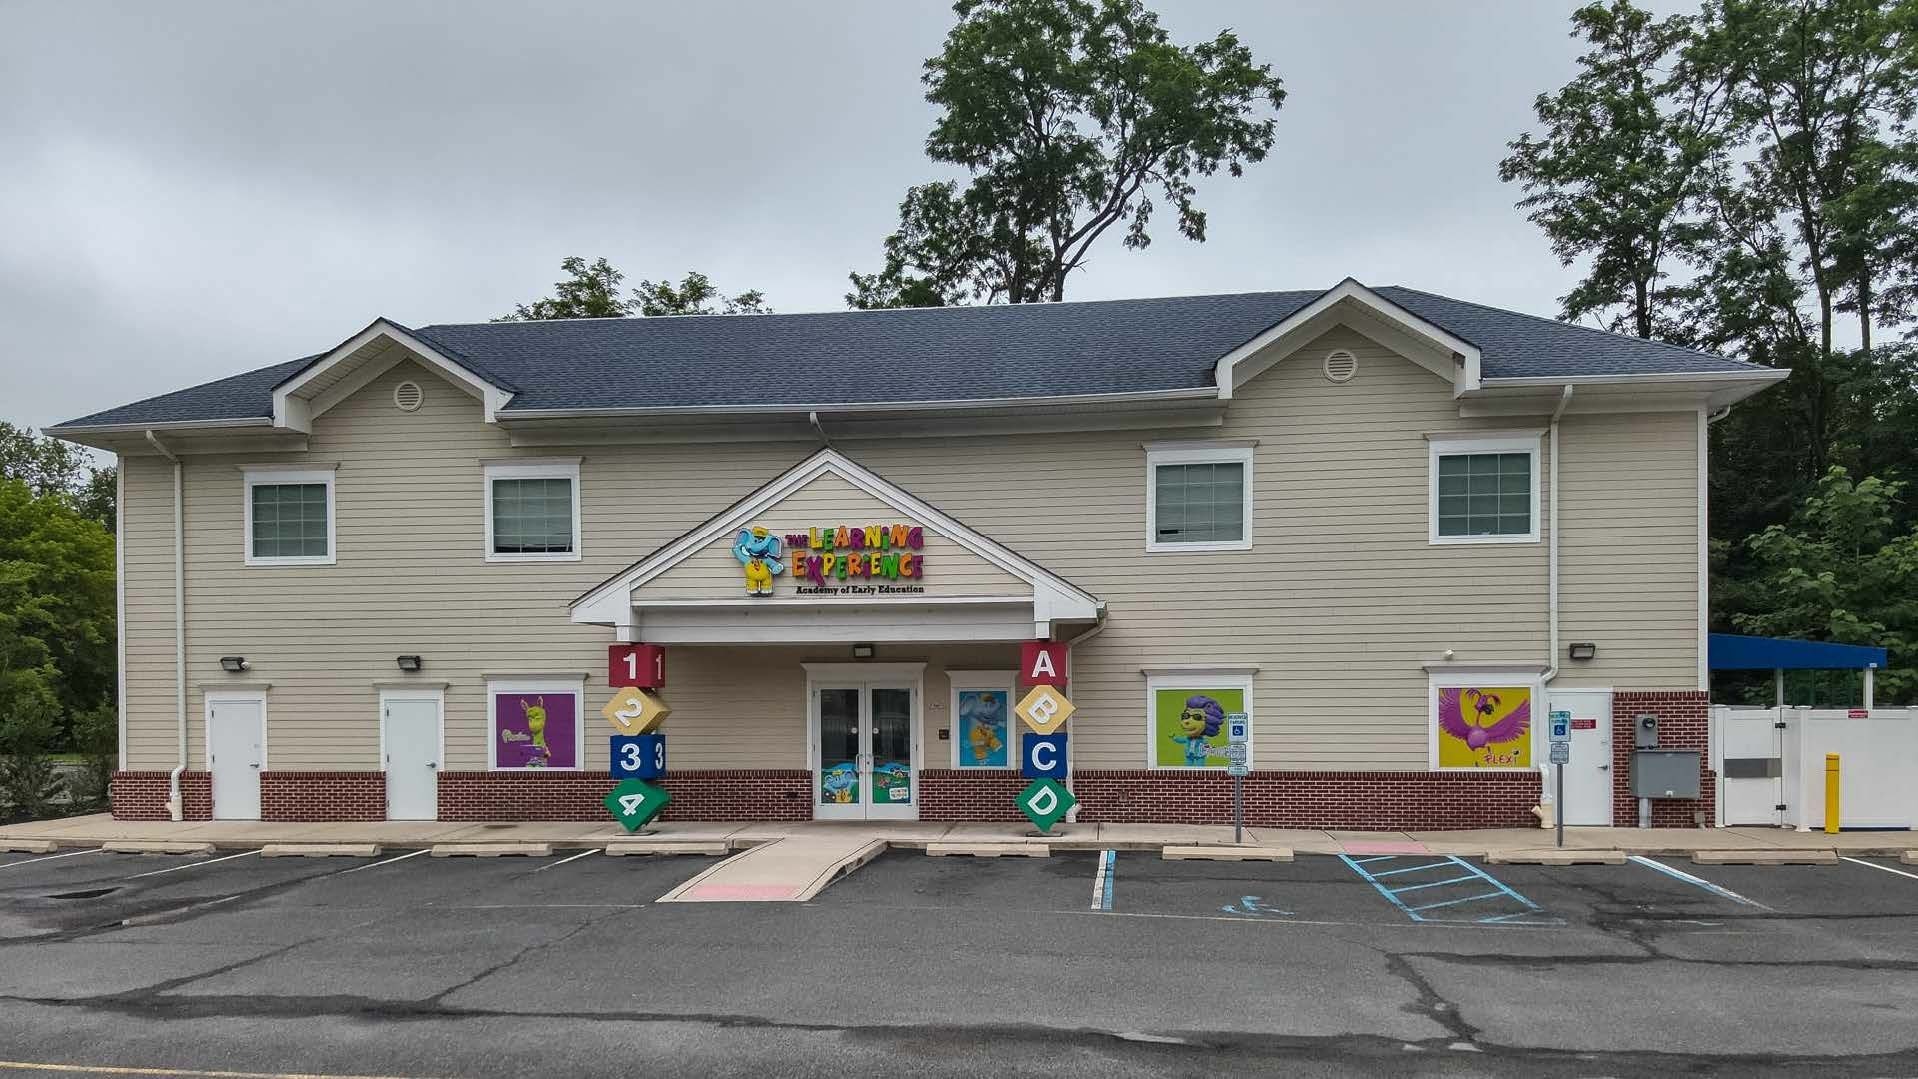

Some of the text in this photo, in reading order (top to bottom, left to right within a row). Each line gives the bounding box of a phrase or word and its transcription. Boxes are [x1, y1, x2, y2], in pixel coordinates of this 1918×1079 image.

[796, 585, 924, 595] Academy of Early Education
[622, 652, 637, 680] 1
[655, 653, 663, 680] 1
[1031, 650, 1056, 678] A
[614, 698, 643, 728] 2
[1027, 692, 1058, 724] B
[620, 743, 641, 771] 3
[655, 742, 664, 770] 3
[1031, 741, 1057, 771] C
[618, 793, 645, 817] 4
[1027, 785, 1058, 816] D
